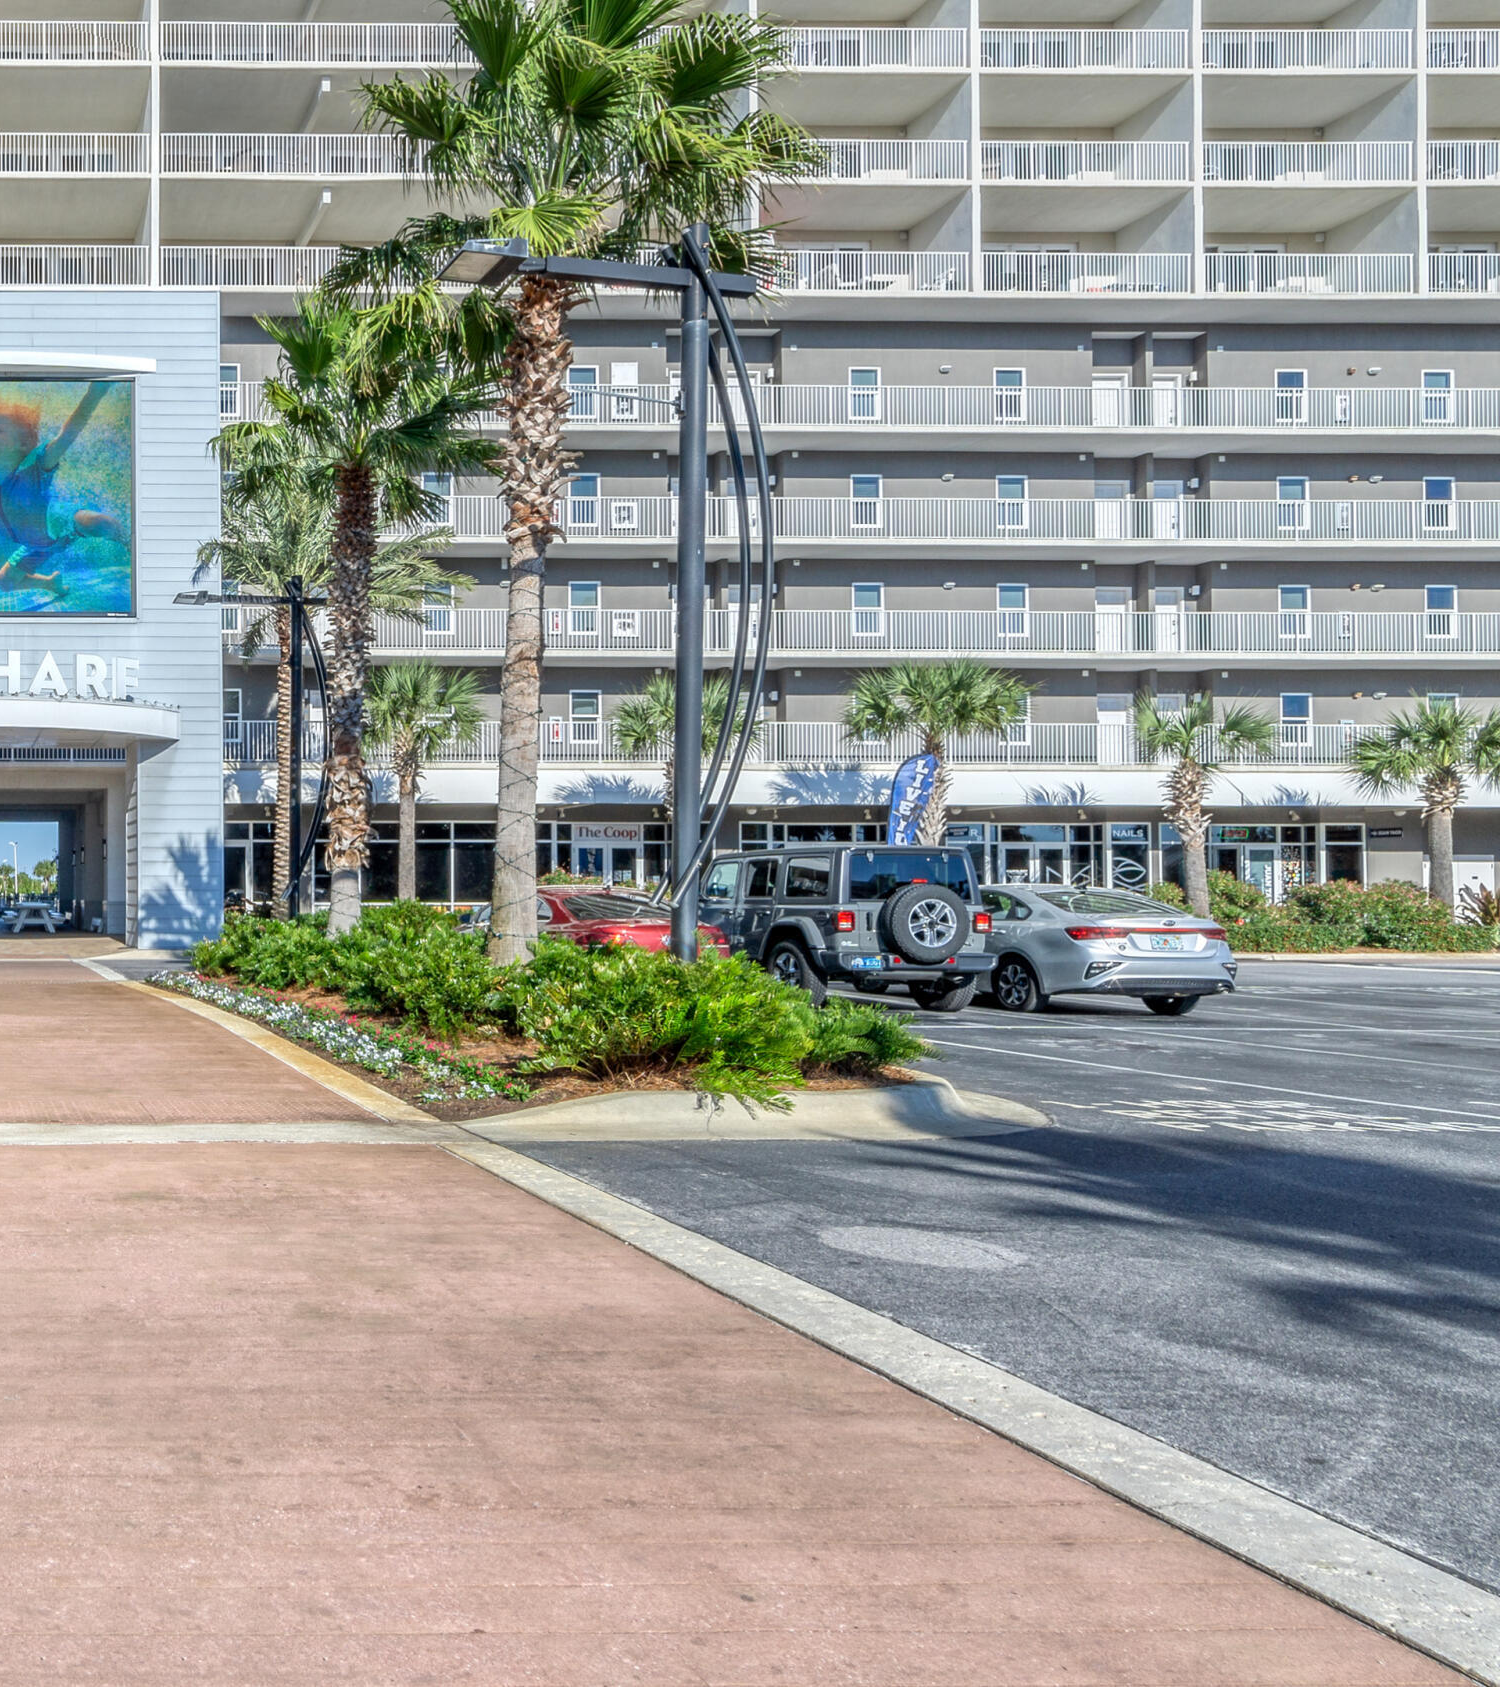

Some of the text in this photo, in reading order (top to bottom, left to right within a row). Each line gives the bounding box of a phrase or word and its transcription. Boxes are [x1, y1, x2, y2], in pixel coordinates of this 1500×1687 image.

[898, 759, 929, 816] LIVE
[576, 826, 637, 840] The Coop
[1112, 829, 1144, 838] NAILS
[1101, 1109, 1410, 1120] RETAIL
